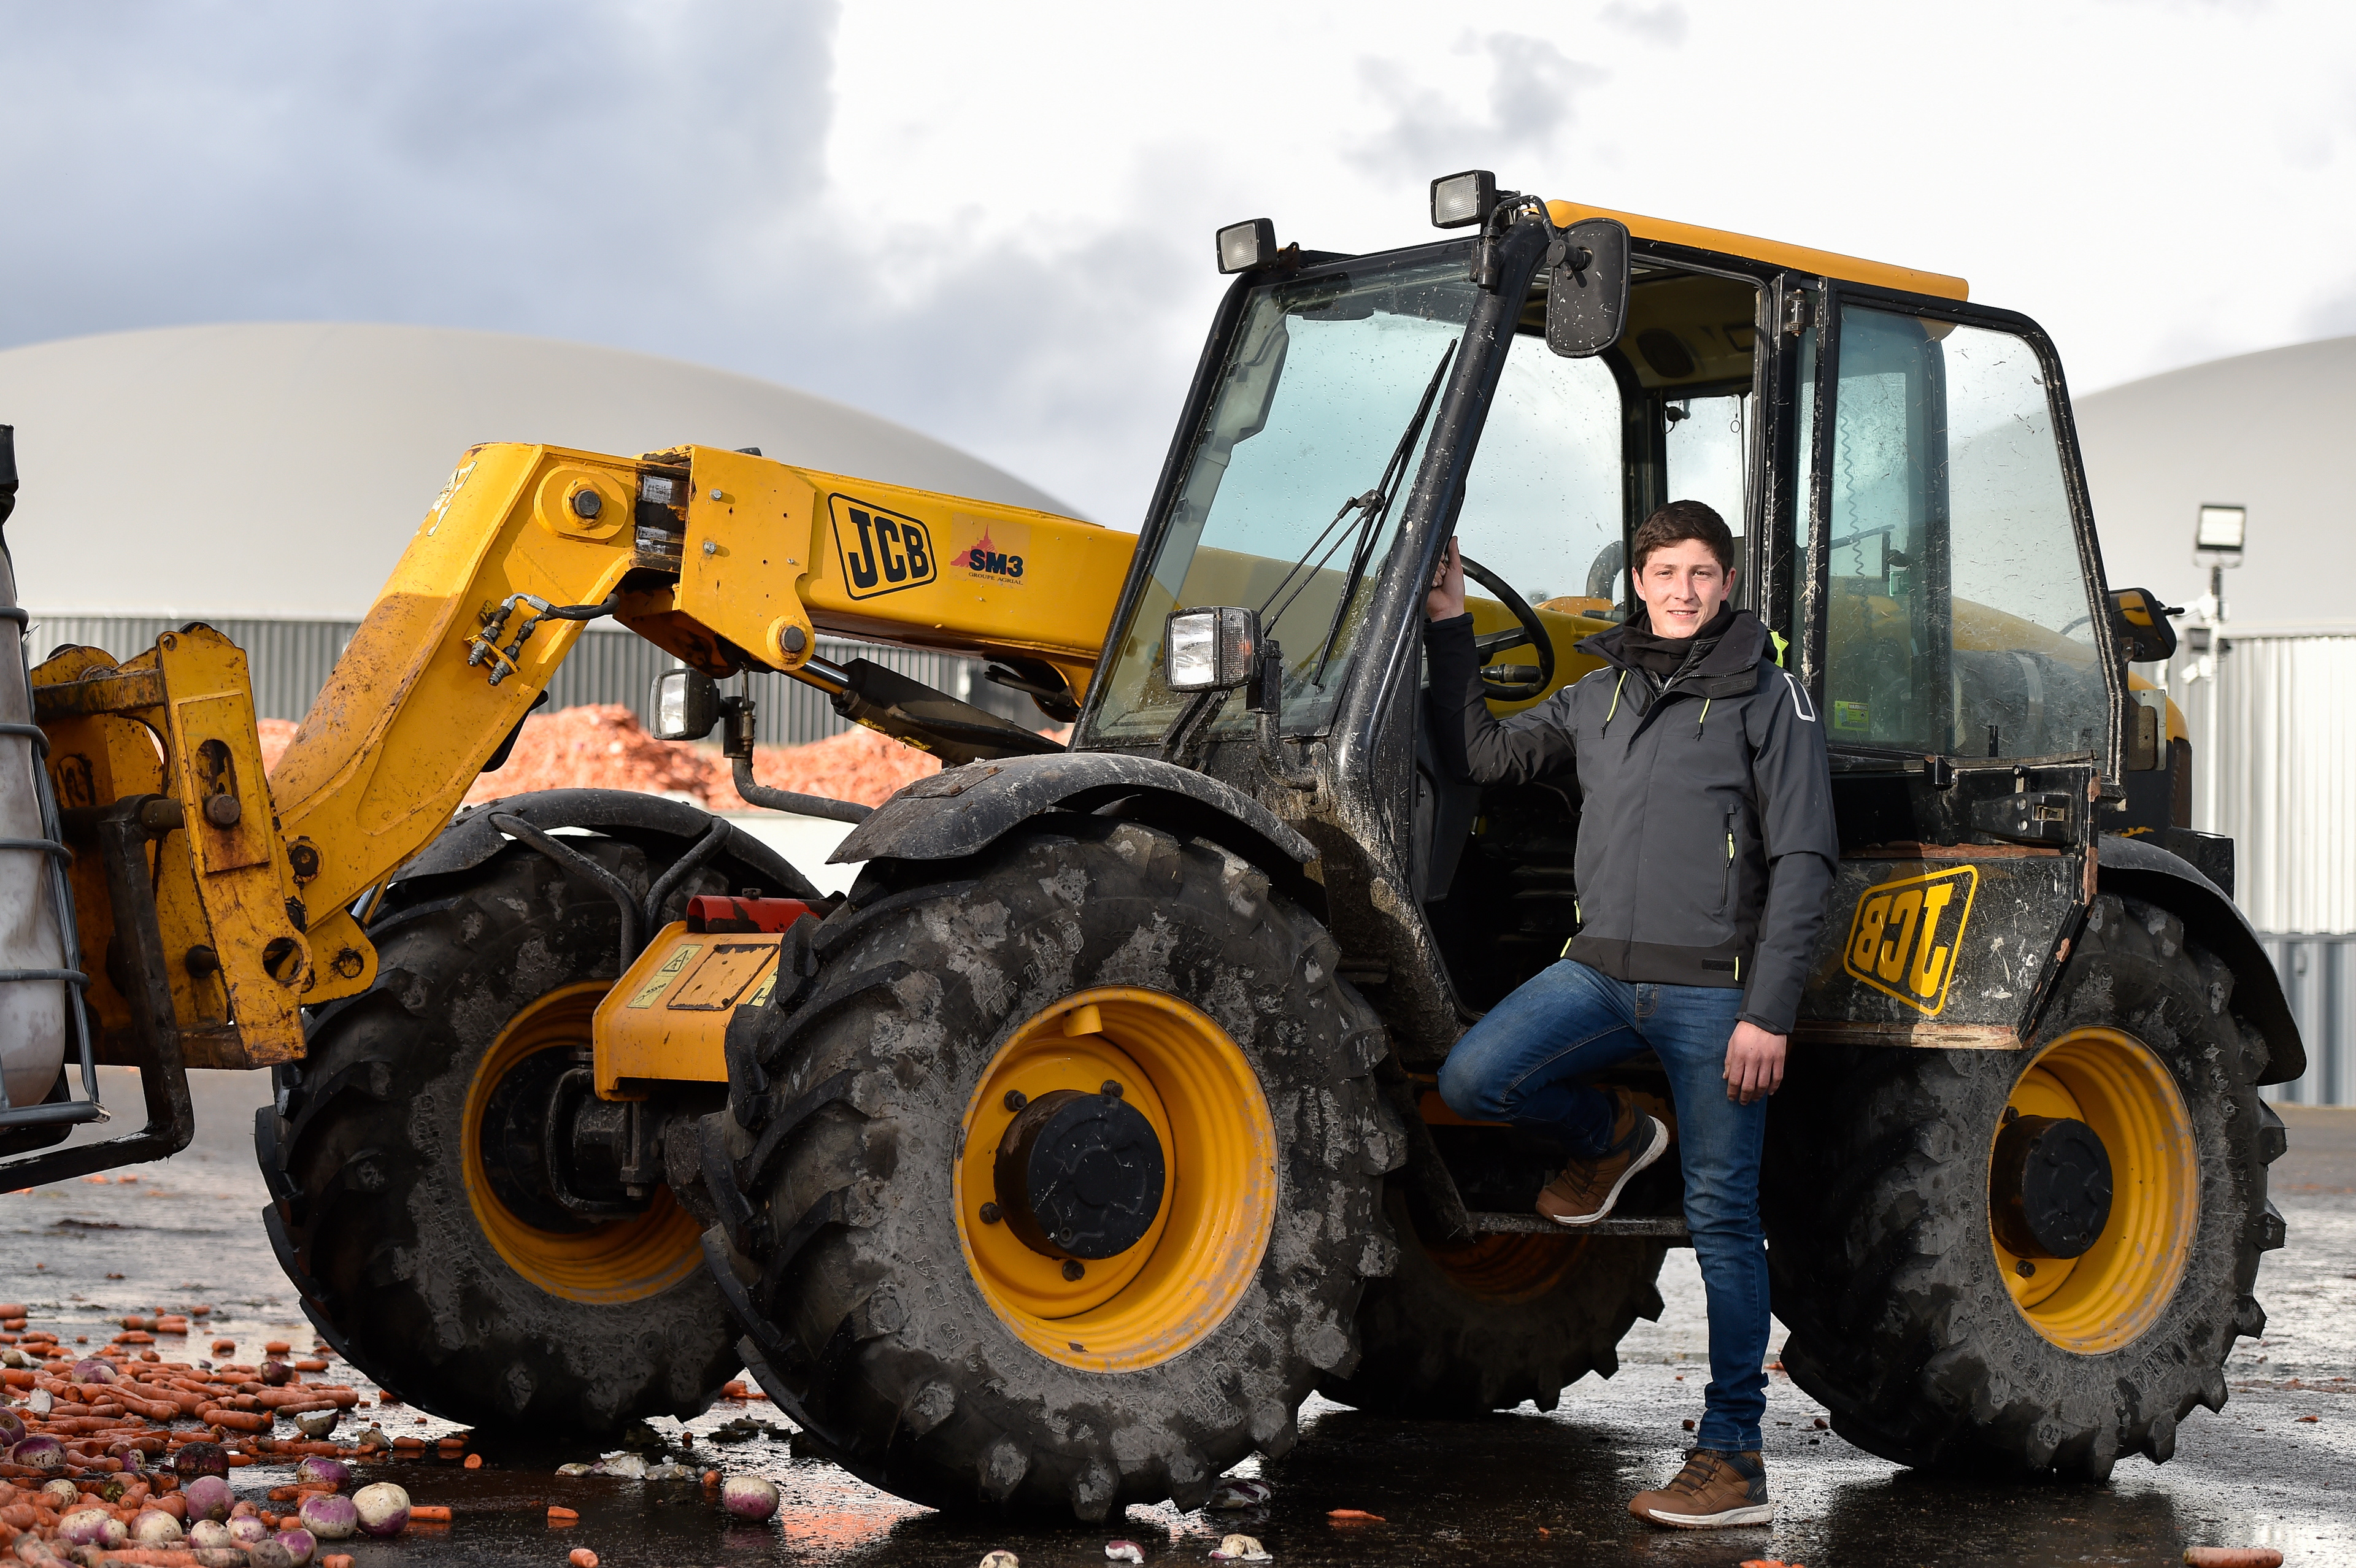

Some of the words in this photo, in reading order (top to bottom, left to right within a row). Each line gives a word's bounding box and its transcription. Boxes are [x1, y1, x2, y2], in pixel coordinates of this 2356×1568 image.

[847, 507, 930, 588] JCB
[968, 572, 995, 580] GROUPE
[997, 577, 1023, 585] AGRIAL
[969, 549, 1023, 577] SM3
[910, 920, 1085, 1108] TRELLEBORG
[1178, 1259, 1342, 1434] TRELLEBORG
